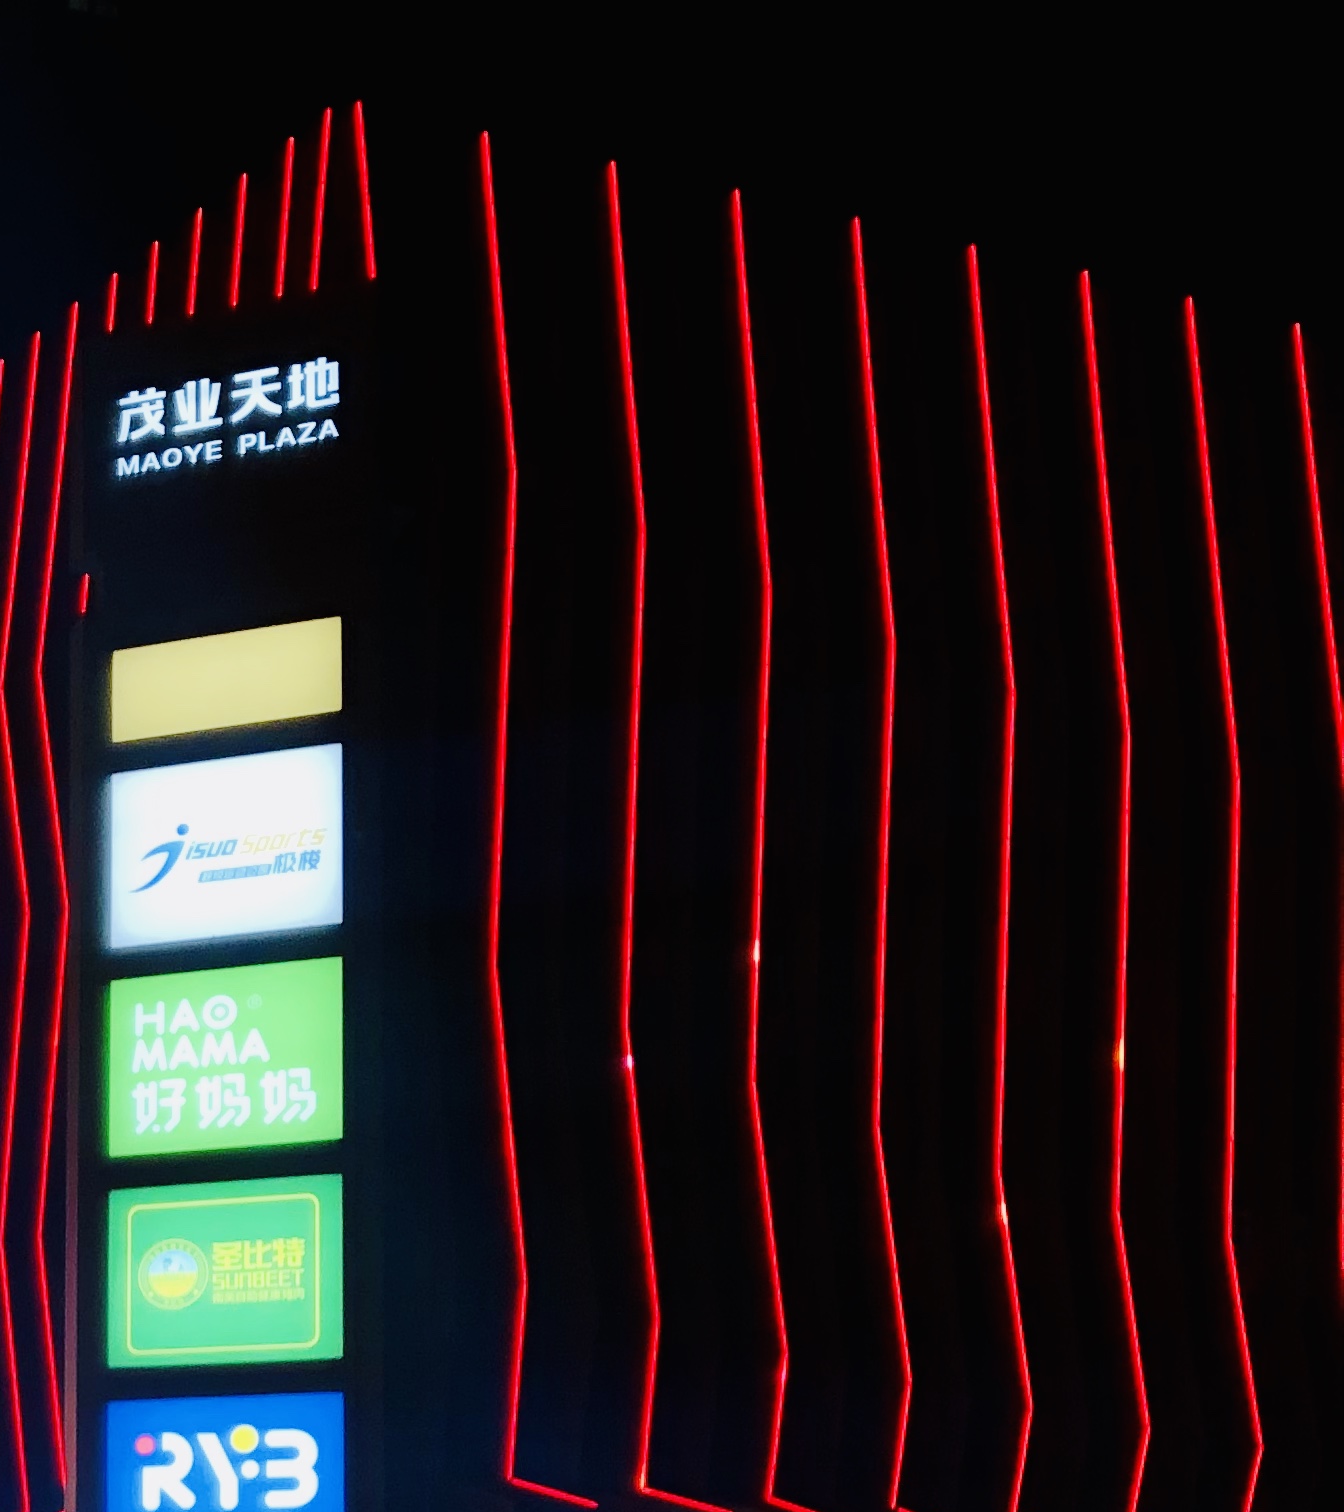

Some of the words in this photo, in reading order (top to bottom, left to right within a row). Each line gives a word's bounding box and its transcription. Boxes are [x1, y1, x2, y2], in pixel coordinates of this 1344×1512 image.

[117, 357, 340, 443] 茂业天地
[116, 440, 223, 478] MAOYE
[238, 419, 340, 456] PLAZA
[135, 994, 238, 1037] HAO
[132, 1028, 270, 1074] MAMA
[132, 1067, 317, 1135] 好妈妈
[135, 1424, 319, 1512] RYB
